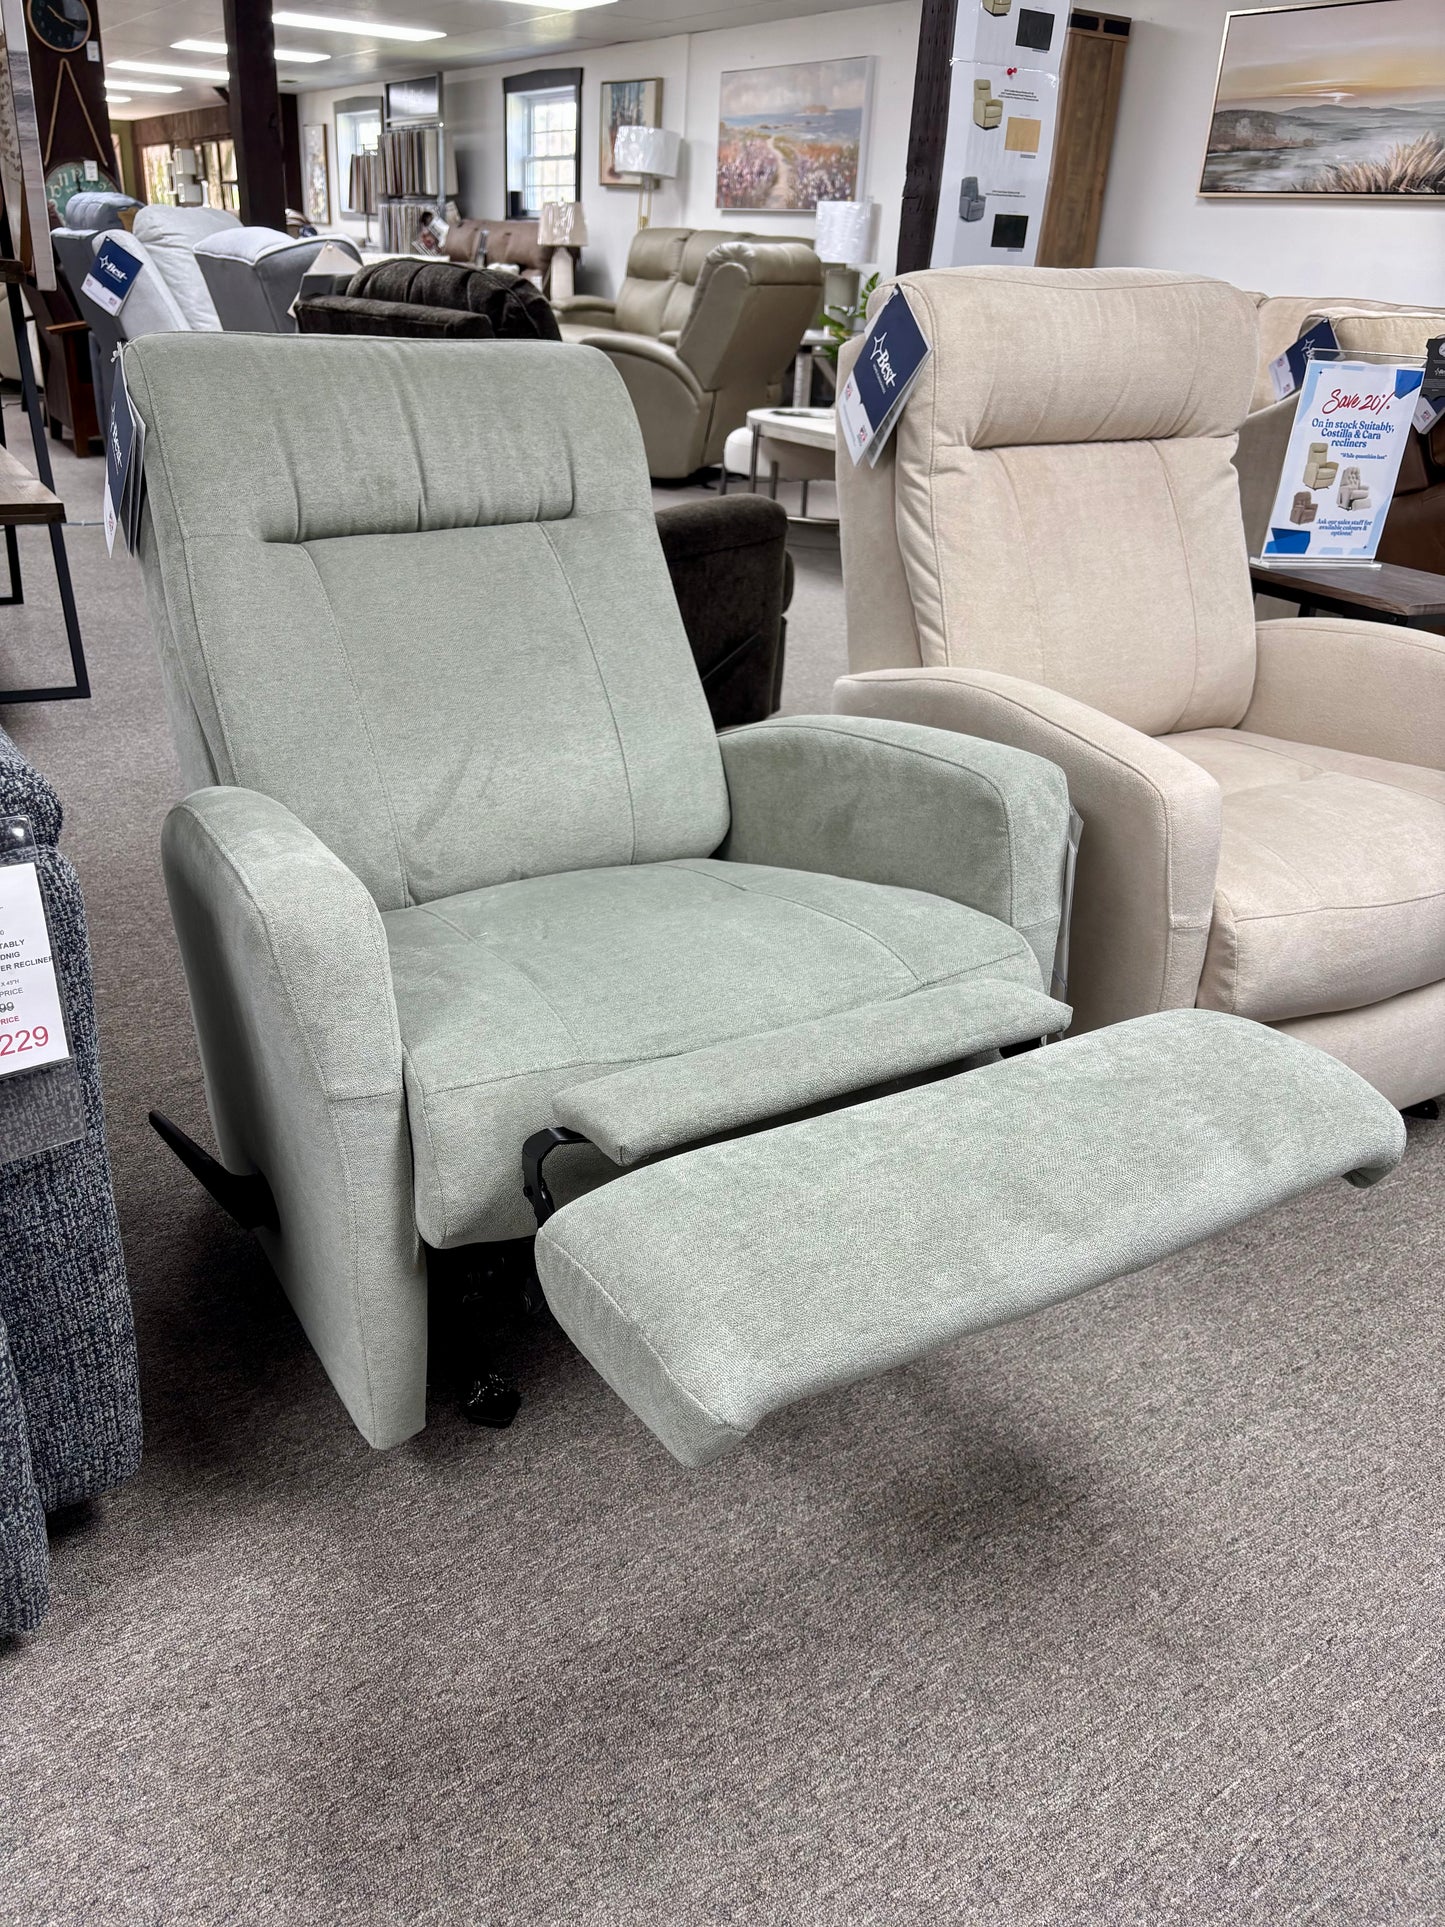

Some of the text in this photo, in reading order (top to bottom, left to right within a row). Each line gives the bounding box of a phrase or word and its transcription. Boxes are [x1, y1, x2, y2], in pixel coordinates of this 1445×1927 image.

[877, 349, 897, 387] Best
[1322, 389, 1395, 415] Save 20%
[1312, 418, 1395, 433] On in stock Suitably,
[1321, 427, 1381, 440] Costilla & Cara
[1331, 438, 1367, 448] recliners
[0, 1026, 49, 1057] 229
